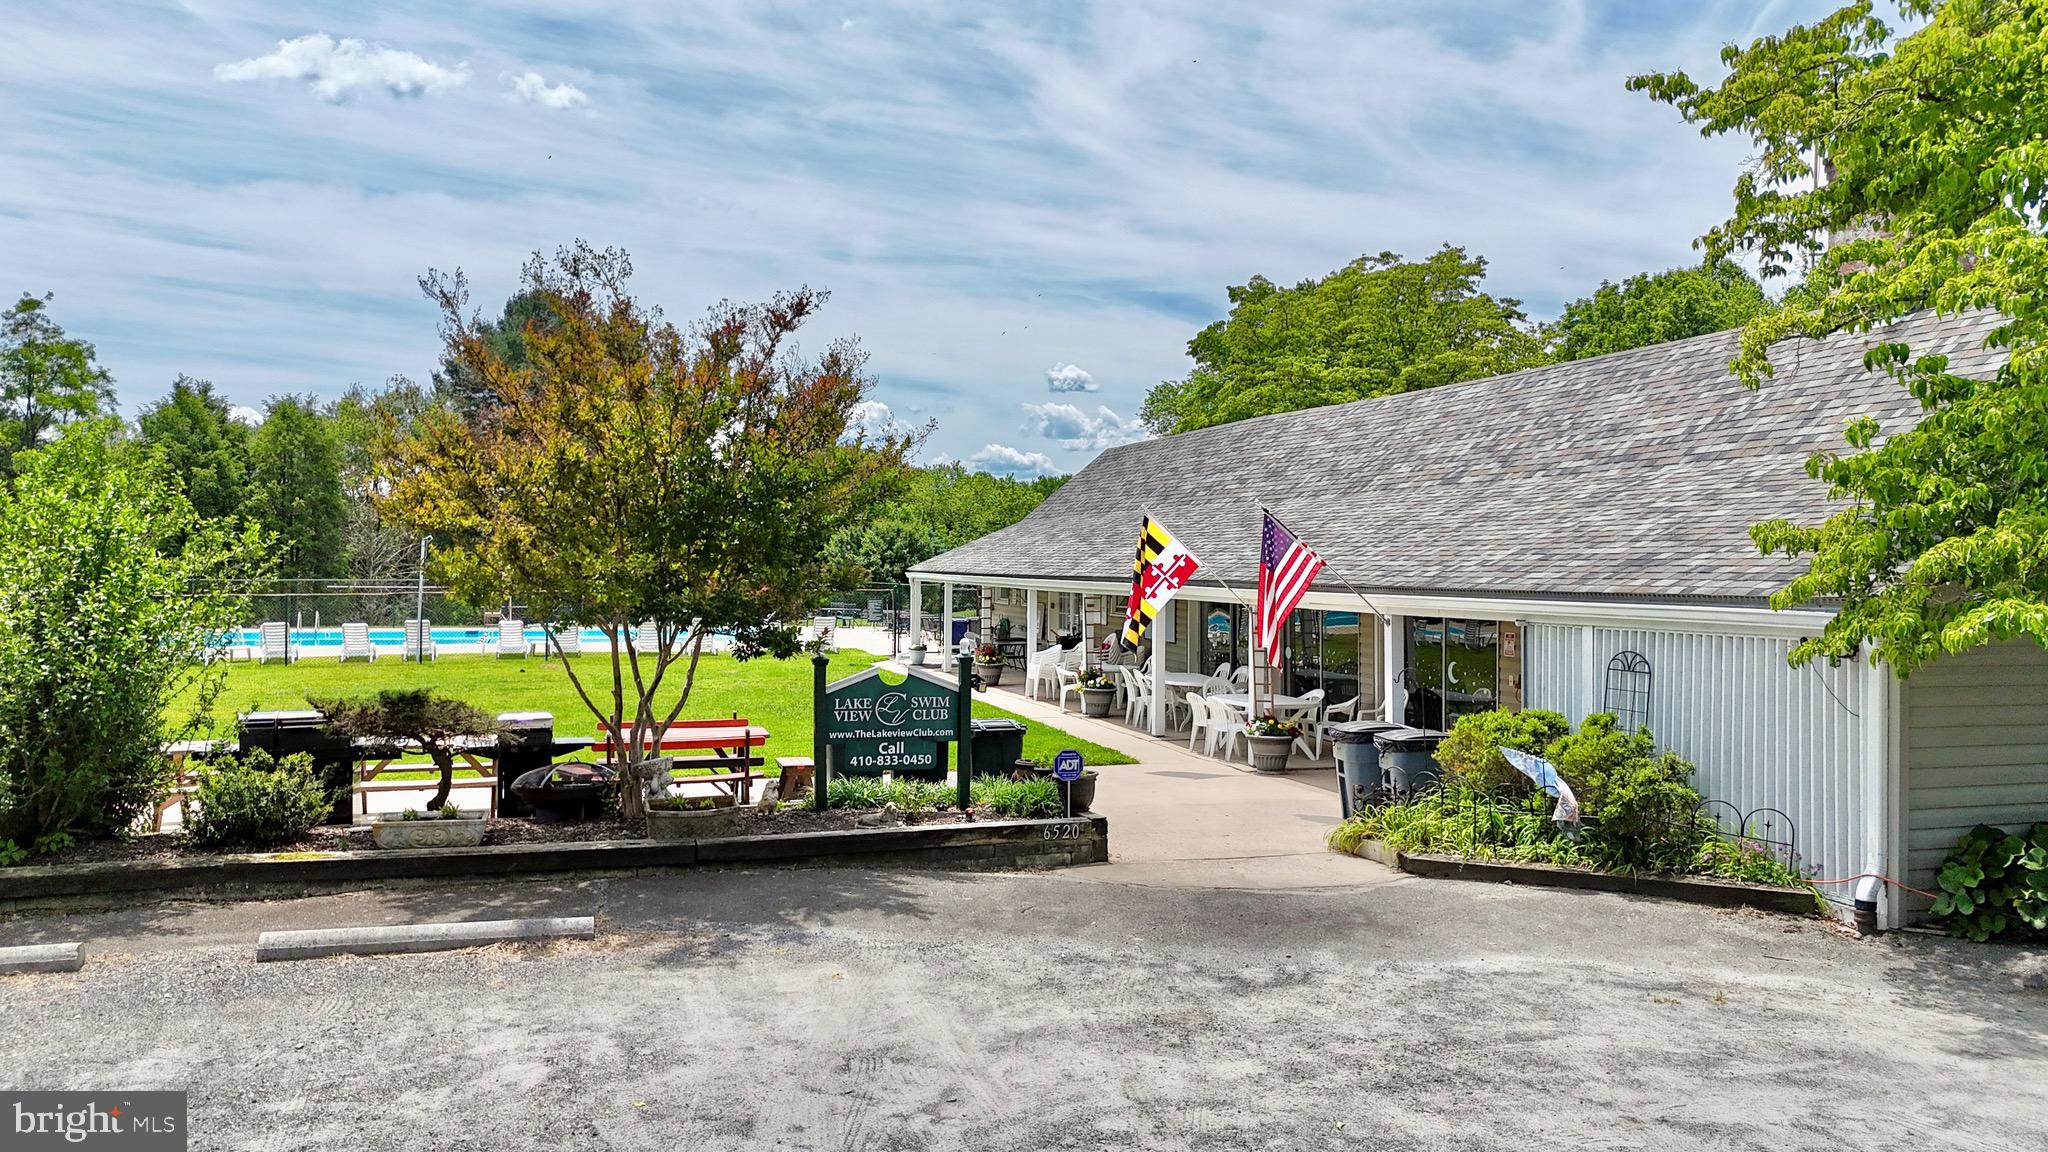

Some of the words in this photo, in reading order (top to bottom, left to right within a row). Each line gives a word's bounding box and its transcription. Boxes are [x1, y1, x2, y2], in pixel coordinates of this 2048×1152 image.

[834, 698, 873, 710] LAKE
[911, 696, 950, 708] SWIM
[833, 710, 873, 722] VIEW
[912, 708, 949, 721] CLUB
[829, 728, 954, 739] www.TheLakeviewClub.com
[878, 741, 905, 755] Call
[850, 754, 932, 767] 410-833-0450
[1059, 759, 1079, 771] ADT
[1043, 824, 1080, 840] 6520
